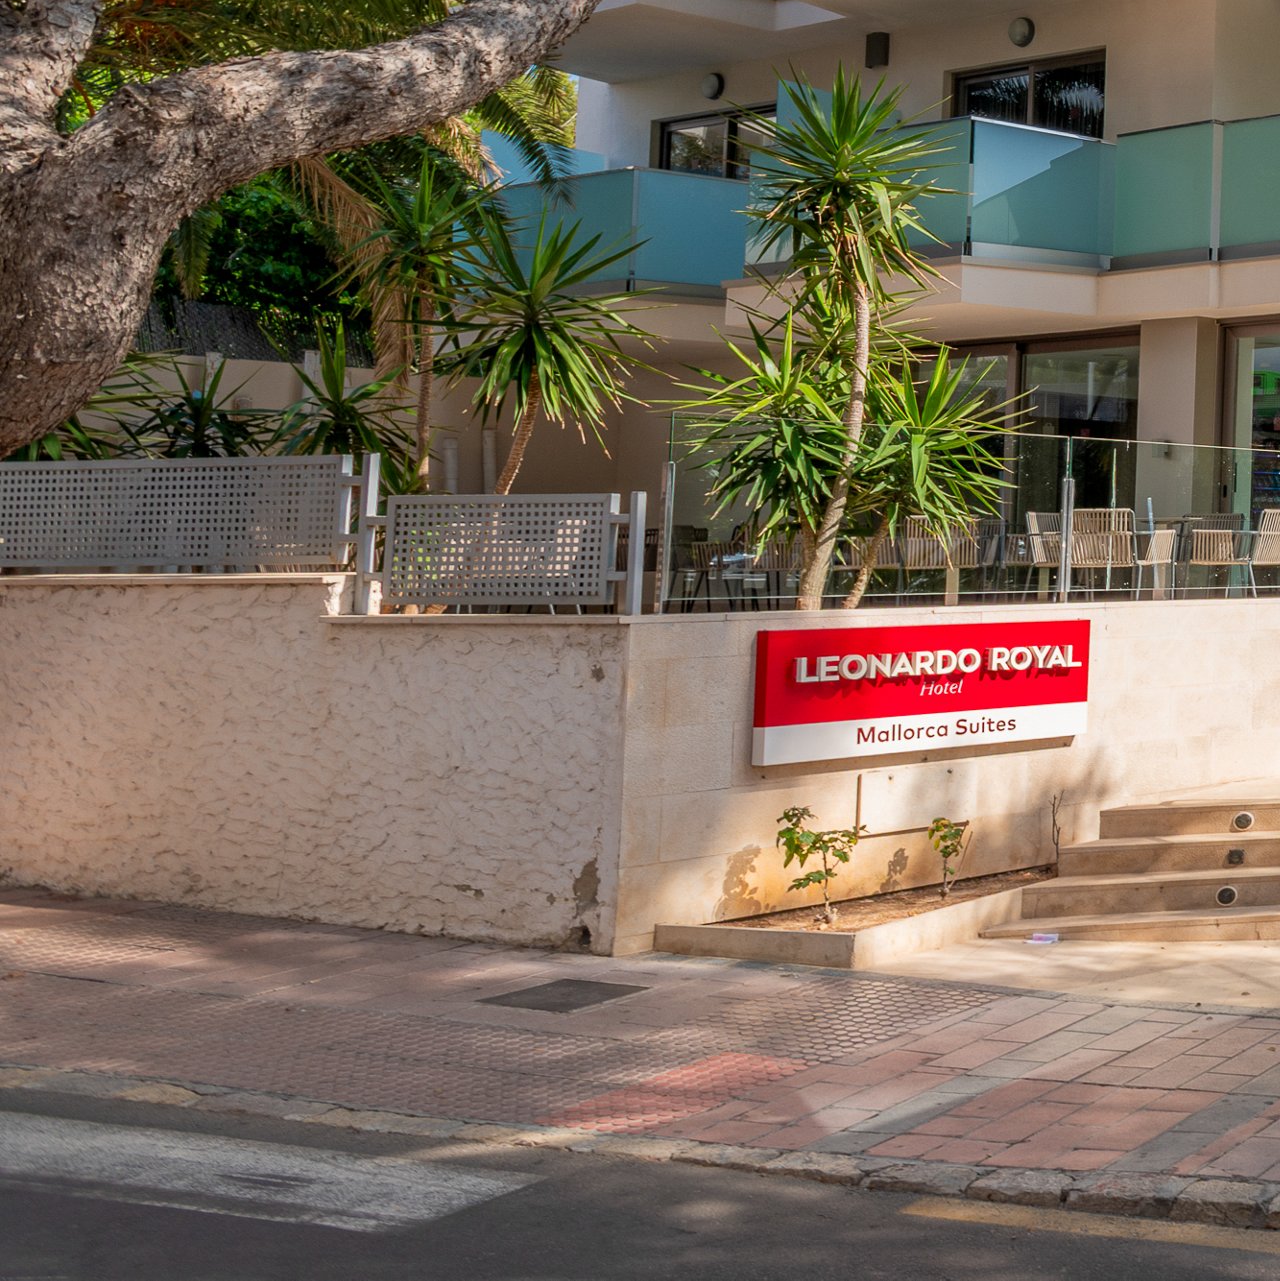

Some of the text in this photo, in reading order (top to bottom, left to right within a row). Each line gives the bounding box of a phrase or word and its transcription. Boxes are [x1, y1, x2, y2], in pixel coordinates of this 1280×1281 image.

[795, 644, 1083, 683] LEONARDO ROYAL
[919, 678, 964, 696] Hotel
[856, 717, 1017, 745] Mallorca Suites
